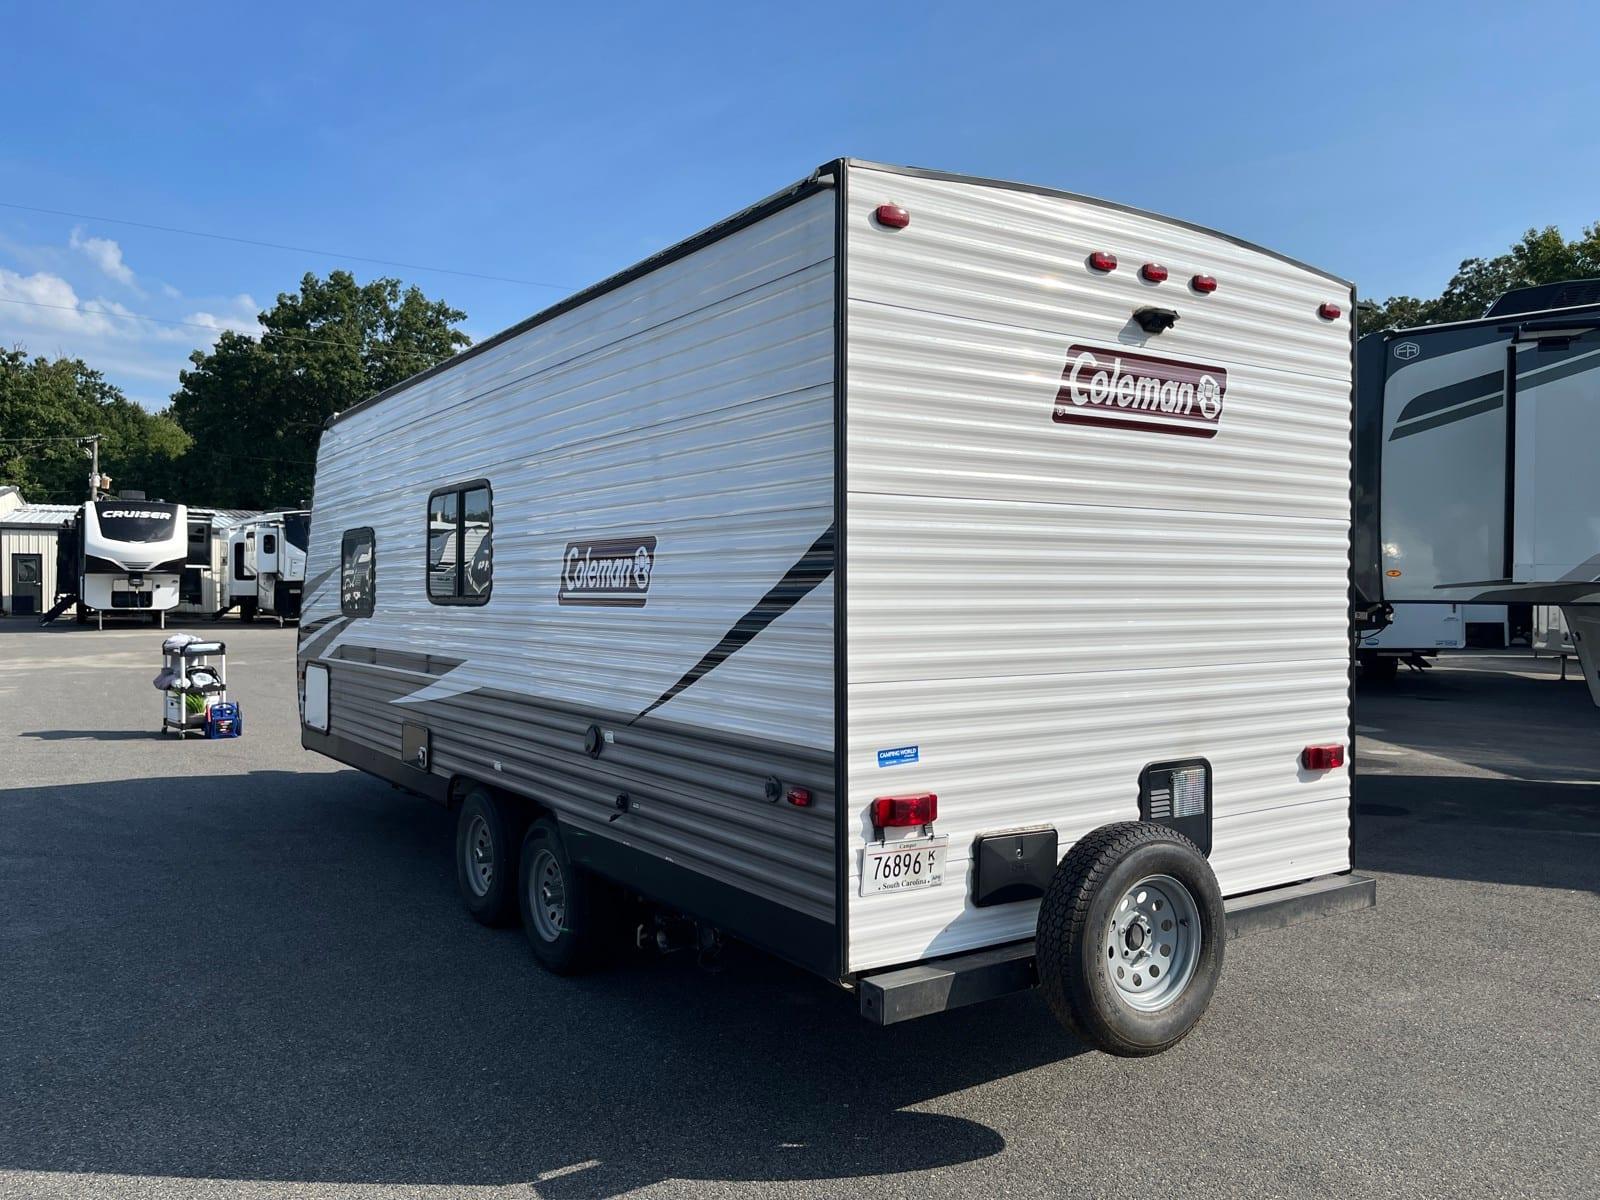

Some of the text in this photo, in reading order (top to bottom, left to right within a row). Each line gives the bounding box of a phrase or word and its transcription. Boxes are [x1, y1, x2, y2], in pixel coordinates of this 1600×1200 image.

[1069, 351, 1194, 416] Coleman
[102, 510, 172, 520] CRUISER
[564, 546, 633, 591] Coleman
[874, 852, 922, 880] 76896
[882, 881, 901, 890] South
[901, 879, 927, 888] Carolina
